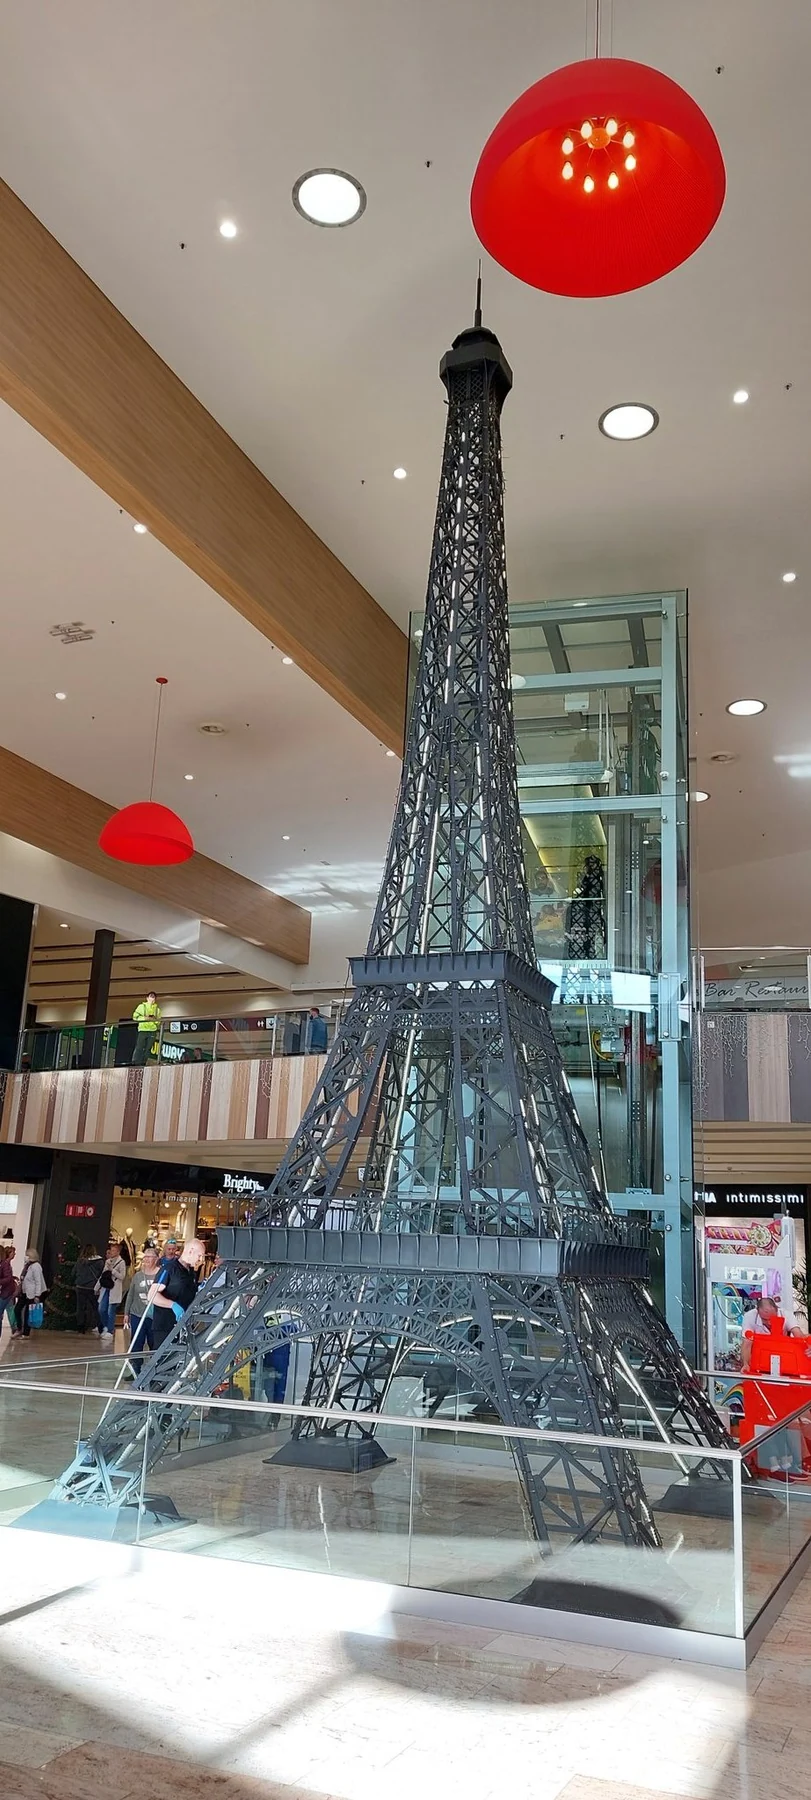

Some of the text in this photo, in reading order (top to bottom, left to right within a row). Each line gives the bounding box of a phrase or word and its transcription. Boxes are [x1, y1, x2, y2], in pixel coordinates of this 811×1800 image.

[703, 982, 736, 997] Bar
[222, 1173, 259, 1194] Brighty
[726, 1192, 804, 1203] intimissimi
